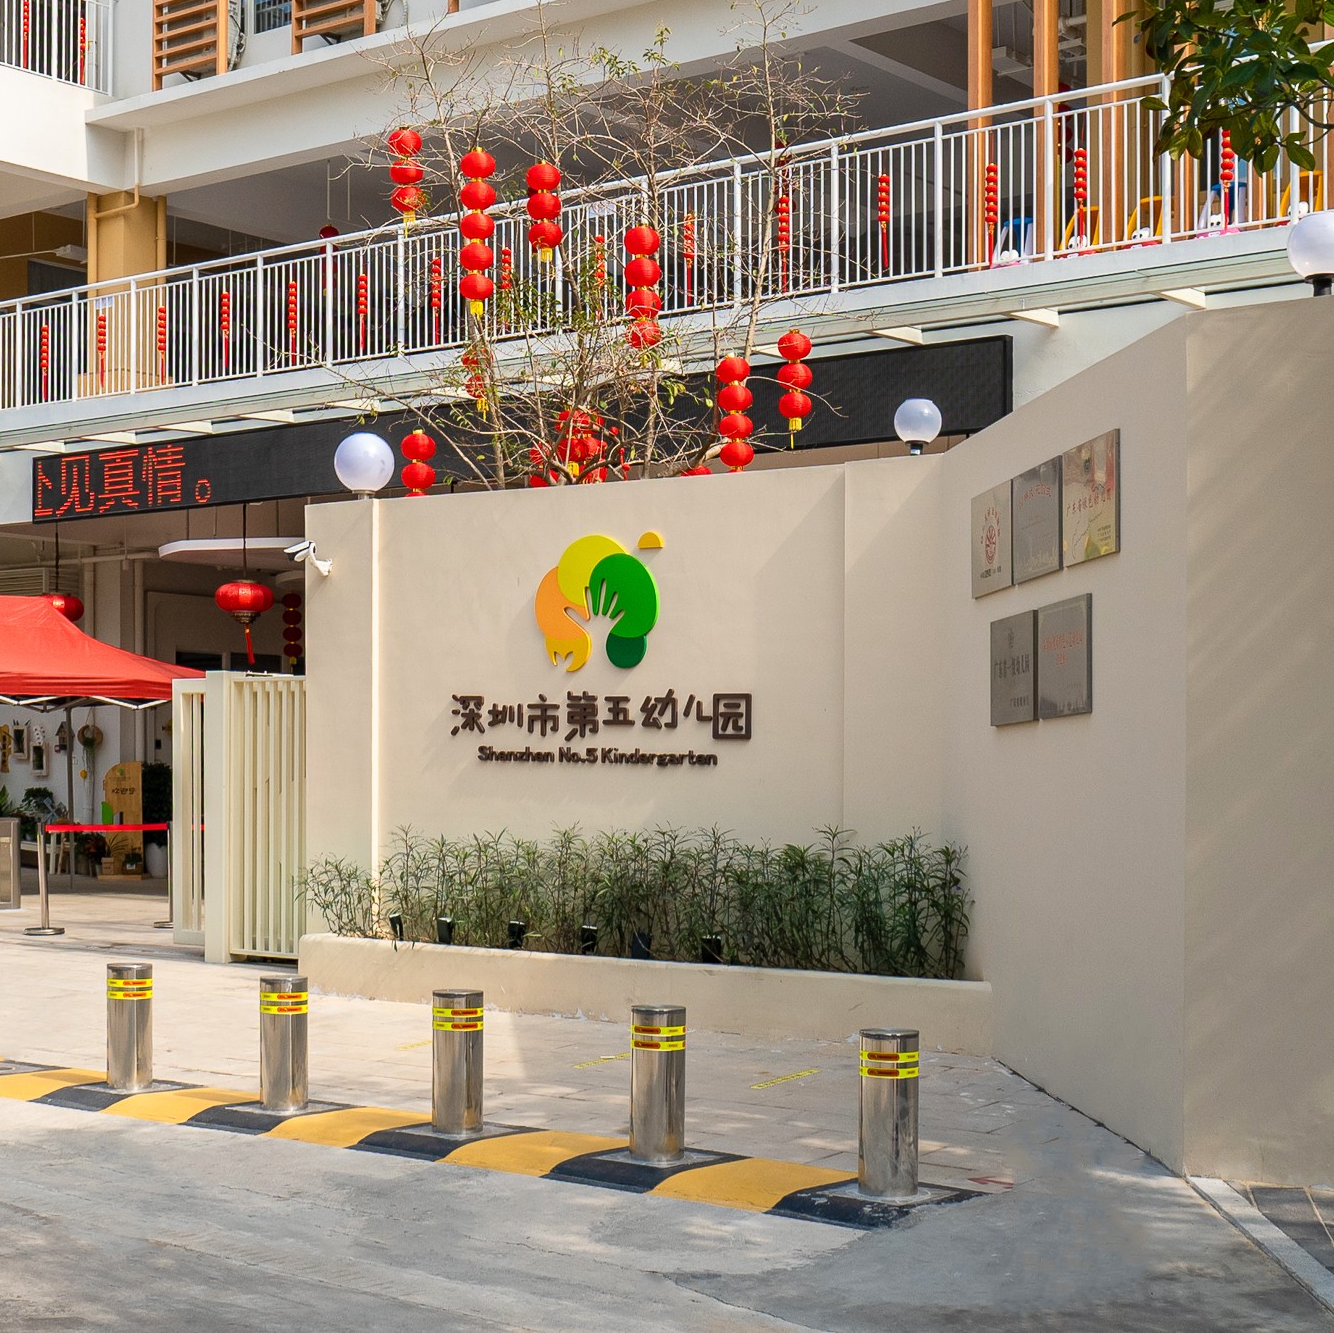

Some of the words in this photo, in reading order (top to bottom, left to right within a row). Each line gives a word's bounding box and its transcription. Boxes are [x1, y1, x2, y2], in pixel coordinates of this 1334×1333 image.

[450, 688, 753, 742] 深圳市第五幼儿园
[477, 745, 555, 764] Shenzhen
[558, 747, 599, 764] No.5
[601, 747, 718, 768] Kindergarten
